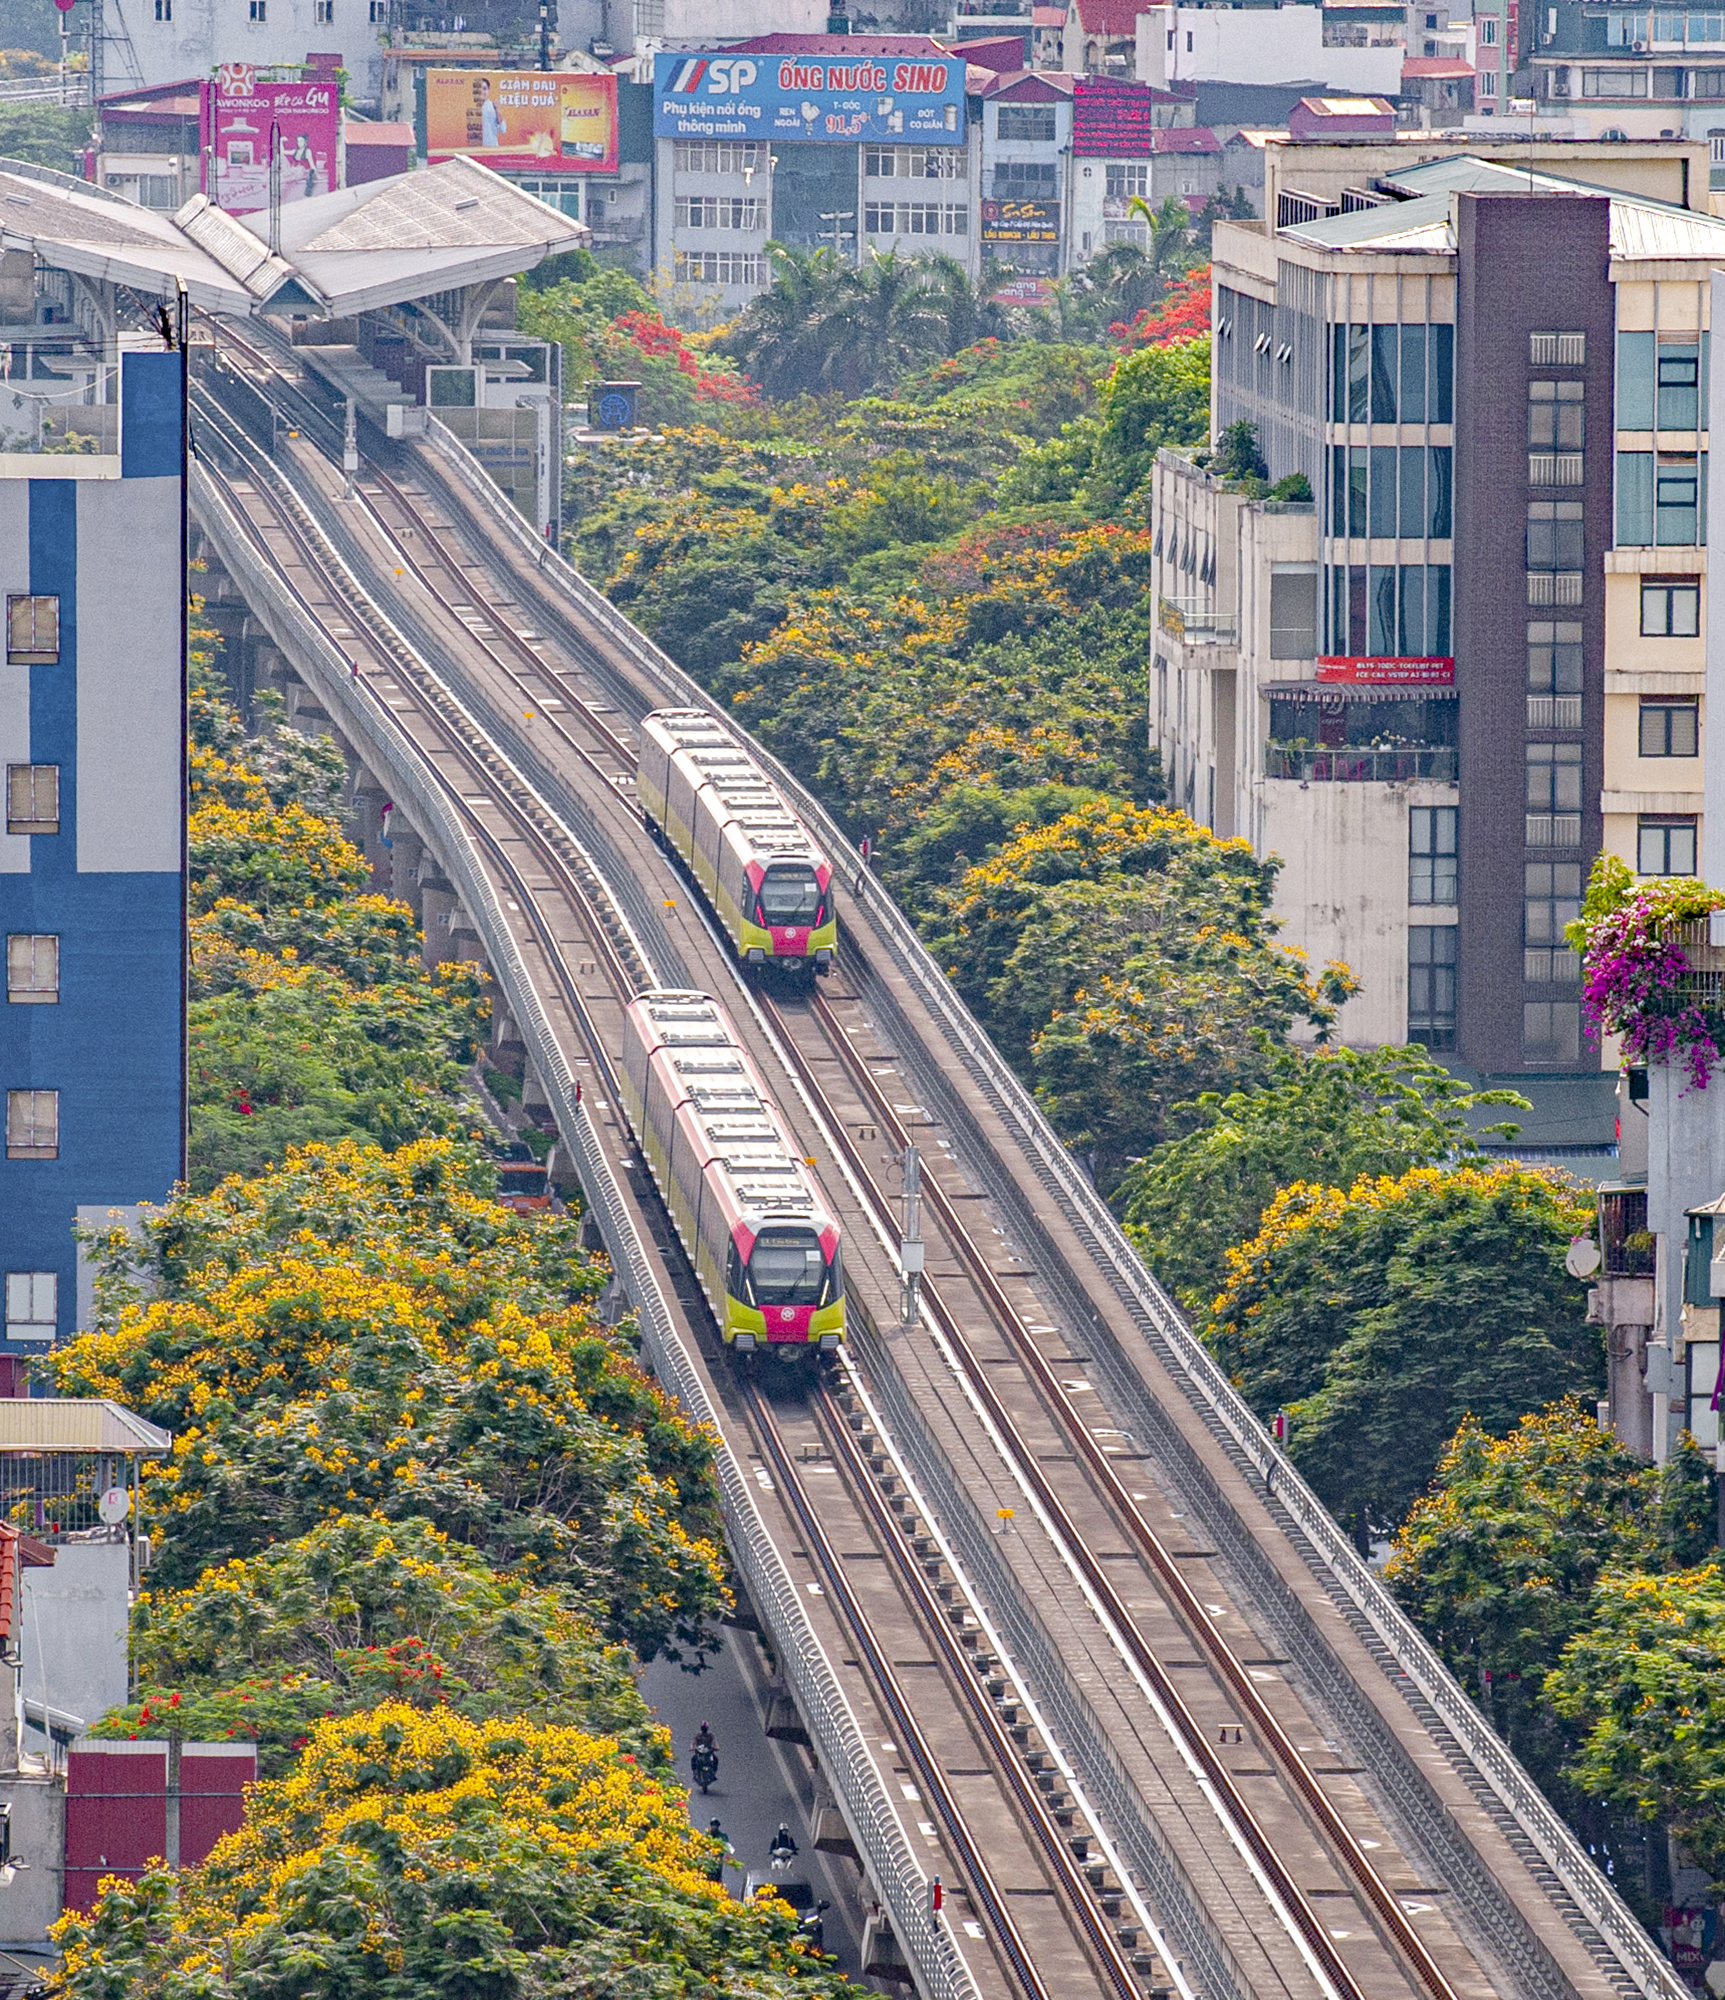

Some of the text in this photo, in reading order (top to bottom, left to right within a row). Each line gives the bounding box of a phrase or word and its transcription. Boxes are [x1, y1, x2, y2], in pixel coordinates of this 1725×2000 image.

[708, 57, 948, 94] SP ỐNG NƯỚC SINO
[500, 76, 530, 91] GIẢM
[500, 93, 529, 108] HIỆU
[663, 100, 762, 119] Phụ kiện nối ống
[678, 120, 747, 135] thông minh
